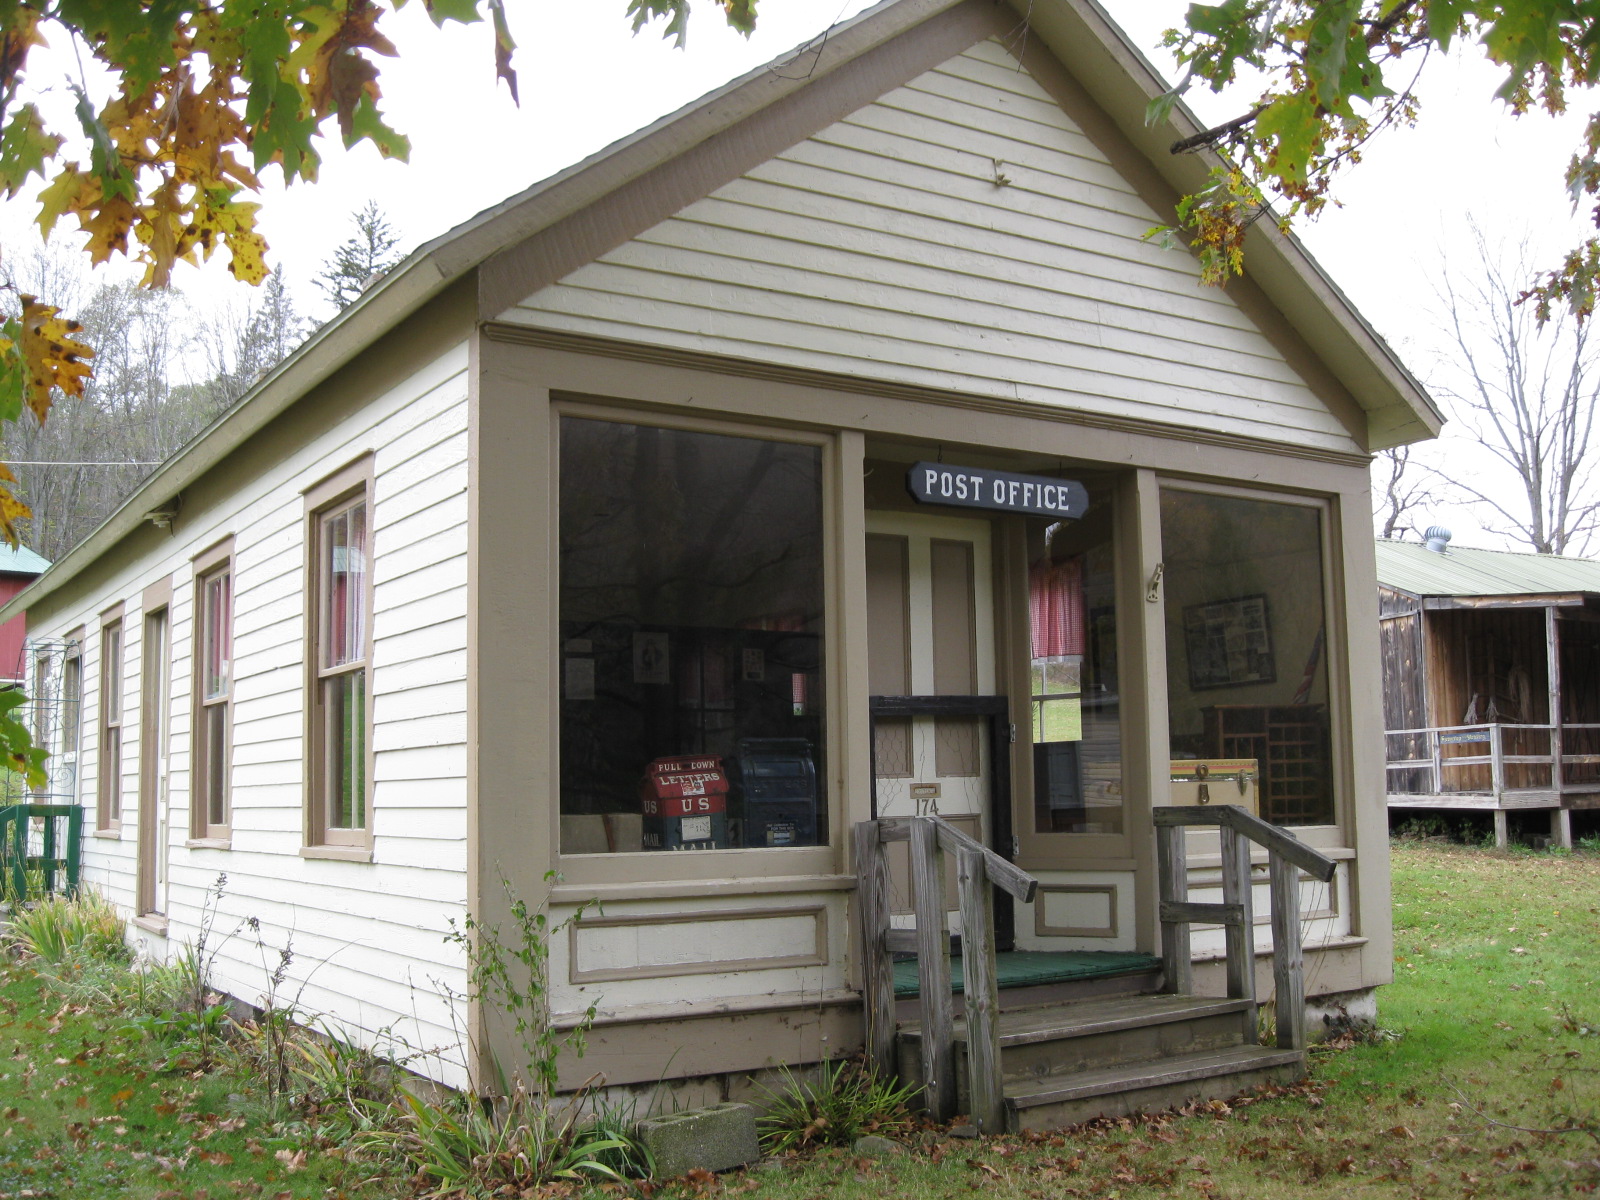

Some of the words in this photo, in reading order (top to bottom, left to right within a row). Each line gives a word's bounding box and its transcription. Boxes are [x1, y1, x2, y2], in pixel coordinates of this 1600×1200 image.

[925, 469, 983, 501] POST
[993, 479, 1069, 511] OFFICE
[658, 763, 682, 772] PULL
[659, 772, 720, 785] LETTERS
[644, 800, 657, 815] US
[916, 799, 939, 816] 174
[643, 833, 662, 847] MAIL
